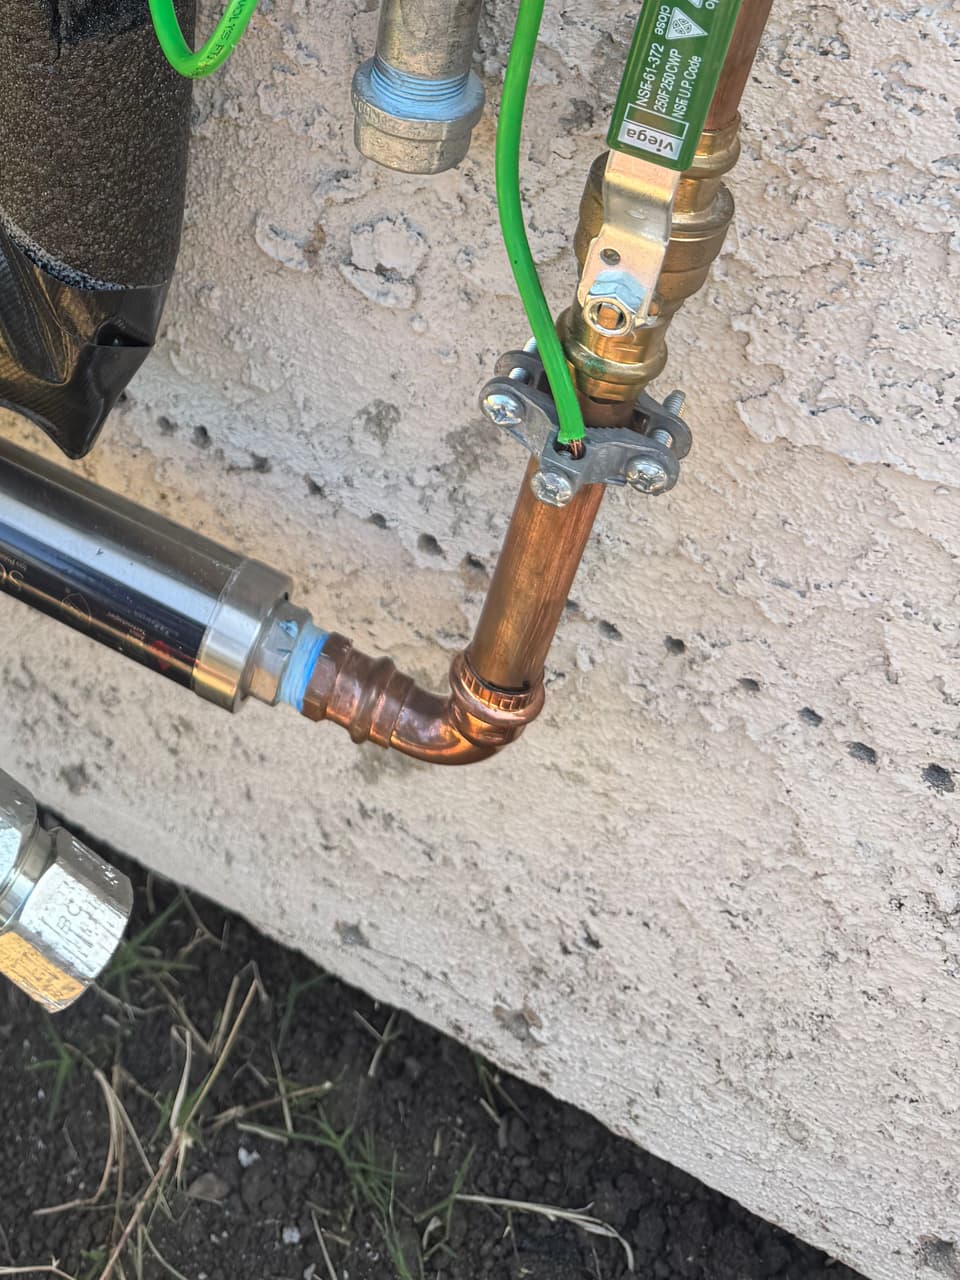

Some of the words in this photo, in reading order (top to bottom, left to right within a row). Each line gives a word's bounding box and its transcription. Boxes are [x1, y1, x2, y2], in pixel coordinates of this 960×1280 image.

[654, 4, 671, 36] close
[665, 48, 682, 73] CWP
[683, 55, 702, 80] Code
[660, 72, 676, 92] 250
[678, 79, 695, 99] U.P.
[653, 87, 671, 114] 250F
[626, 127, 674, 153] viega
